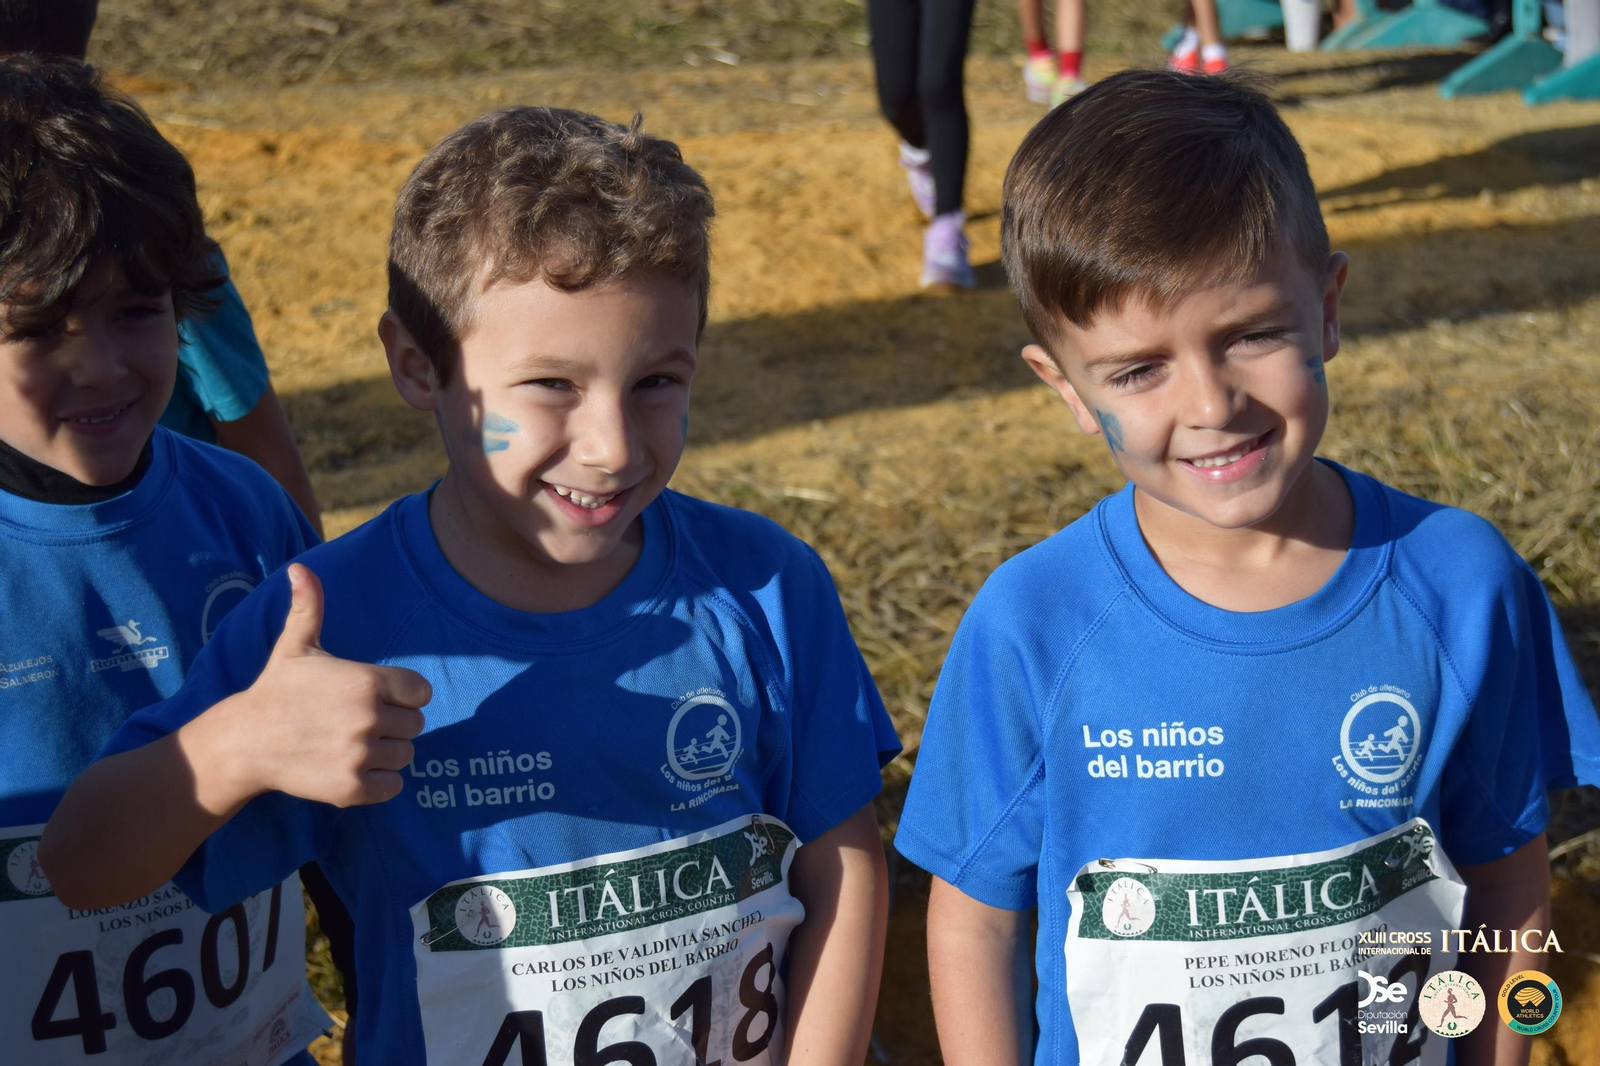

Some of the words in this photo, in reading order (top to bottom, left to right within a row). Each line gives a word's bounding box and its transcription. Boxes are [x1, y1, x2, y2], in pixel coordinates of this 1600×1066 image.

[0, 654, 54, 673] AZULEJOS
[670, 695, 686, 710] Club
[1350, 688, 1367, 702] Club
[1368, 685, 1378, 693] de
[1082, 724, 1134, 748] Los
[1142, 721, 1225, 747] niños
[409, 758, 460, 778] Los
[469, 749, 553, 776] niños
[660, 763, 675, 784] Los
[676, 780, 702, 792] niños
[703, 778, 721, 789] del
[1087, 754, 1128, 779] del
[1136, 753, 1225, 779] barrio
[1331, 754, 1349, 778] Los
[1346, 777, 1379, 795] niños
[1381, 782, 1399, 795] del
[416, 783, 457, 809] del
[464, 778, 556, 807] barrio
[670, 802, 686, 812] LA
[688, 783, 740, 809] RINCONADA
[1340, 799, 1353, 809] LA
[545, 854, 736, 929] ITÁLICA
[1184, 863, 1381, 927] ITÁLICA
[99, 915, 132, 933] LOS
[135, 900, 182, 926] NIÑOS
[551, 915, 647, 940] INTERNATIONAL
[651, 907, 684, 921] CROSS
[687, 891, 737, 912] COUNTRY
[1189, 921, 1291, 939] INTERNATIONAL
[1295, 915, 1332, 928] CROSS
[511, 955, 586, 976] CARLOS
[590, 951, 615, 968] DE
[618, 931, 699, 960] VALDIVIA
[1184, 954, 1229, 970] PEPE
[1234, 943, 1315, 967] MORENO
[1319, 923, 1388, 955] FLODO
[551, 975, 587, 992] LOS
[591, 963, 646, 988] NIÑOS
[649, 954, 682, 976] DEL
[685, 938, 739, 967] BARRIO
[1189, 974, 1225, 989] LOS
[1229, 967, 1286, 987] NIÑOS
[1290, 959, 1325, 979] DEL
[1330, 940, 1384, 972] BARR
[482, 941, 779, 1066] 4618
